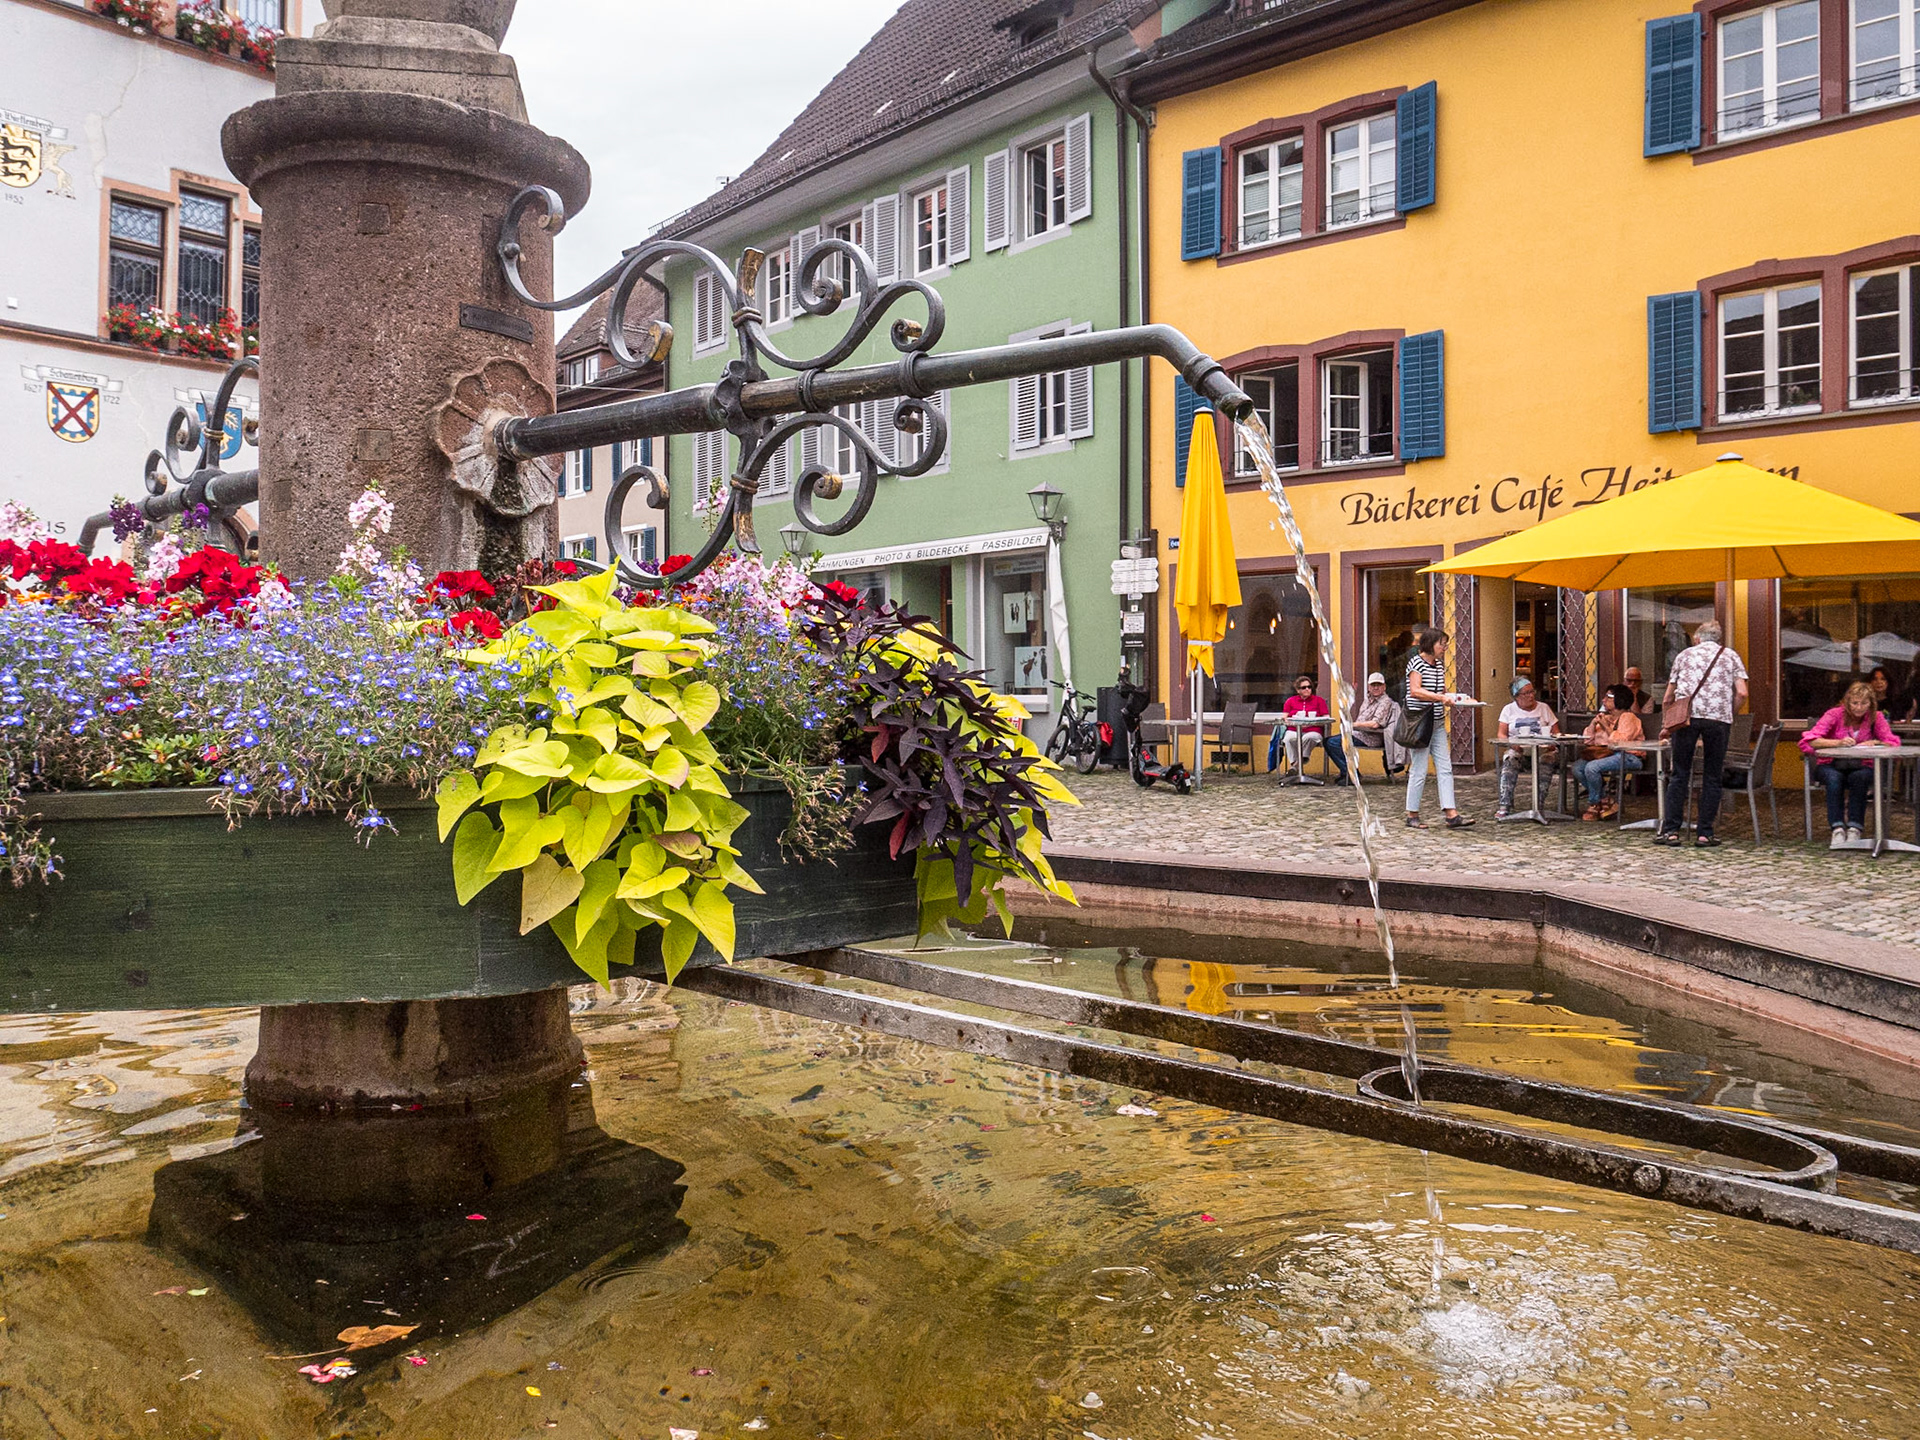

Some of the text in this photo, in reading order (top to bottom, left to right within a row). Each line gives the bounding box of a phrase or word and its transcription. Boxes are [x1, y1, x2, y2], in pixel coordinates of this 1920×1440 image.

[1340, 484, 1481, 526] Bäckerei
[1490, 474, 1564, 523] Café
[874, 552, 903, 563] PHOTO
[906, 551, 912, 560] &
[916, 544, 971, 559] BILDERECKE
[981, 535, 1043, 550] PASSBILDER
